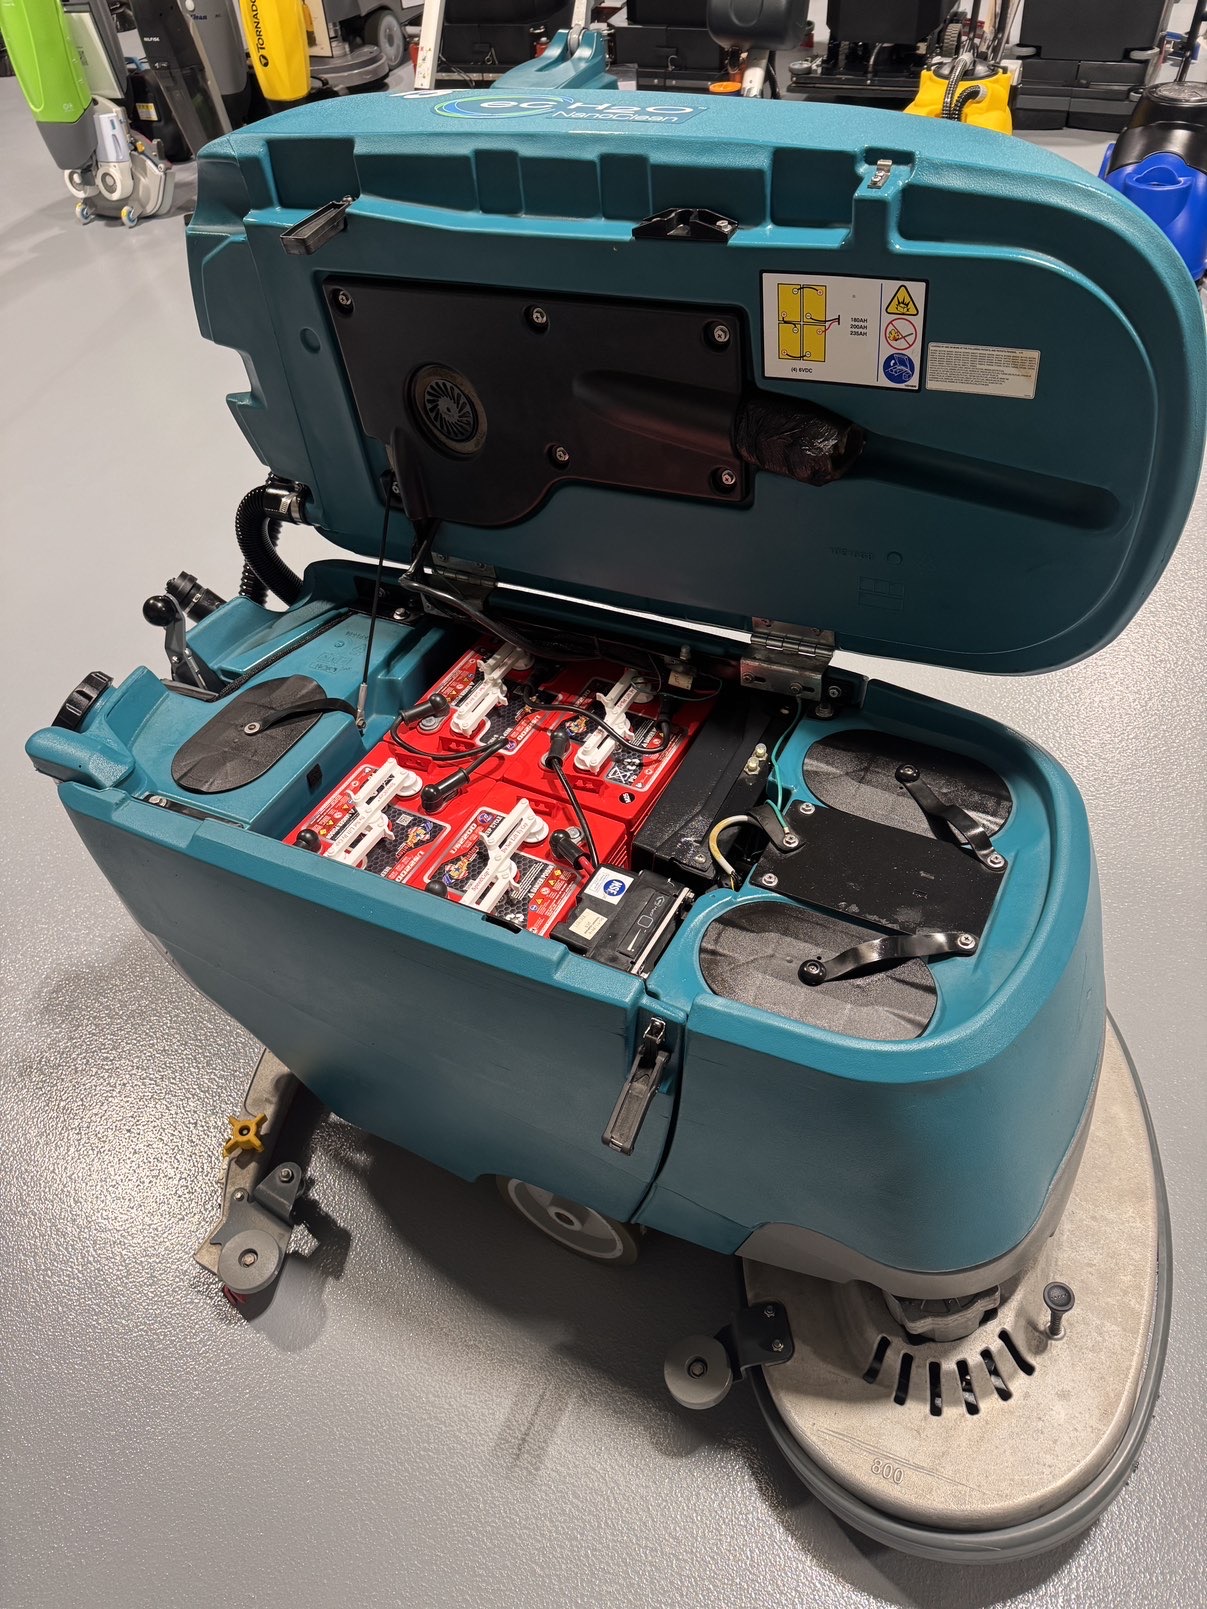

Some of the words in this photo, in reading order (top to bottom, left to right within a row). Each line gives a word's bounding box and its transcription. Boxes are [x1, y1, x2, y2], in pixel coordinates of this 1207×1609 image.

[552, 110, 678, 122] NanoClean
[449, 822, 478, 856] US2200
[395, 849, 424, 884] US2200
[607, 880, 623, 895] NSF
[870, 1457, 904, 1485] 800
